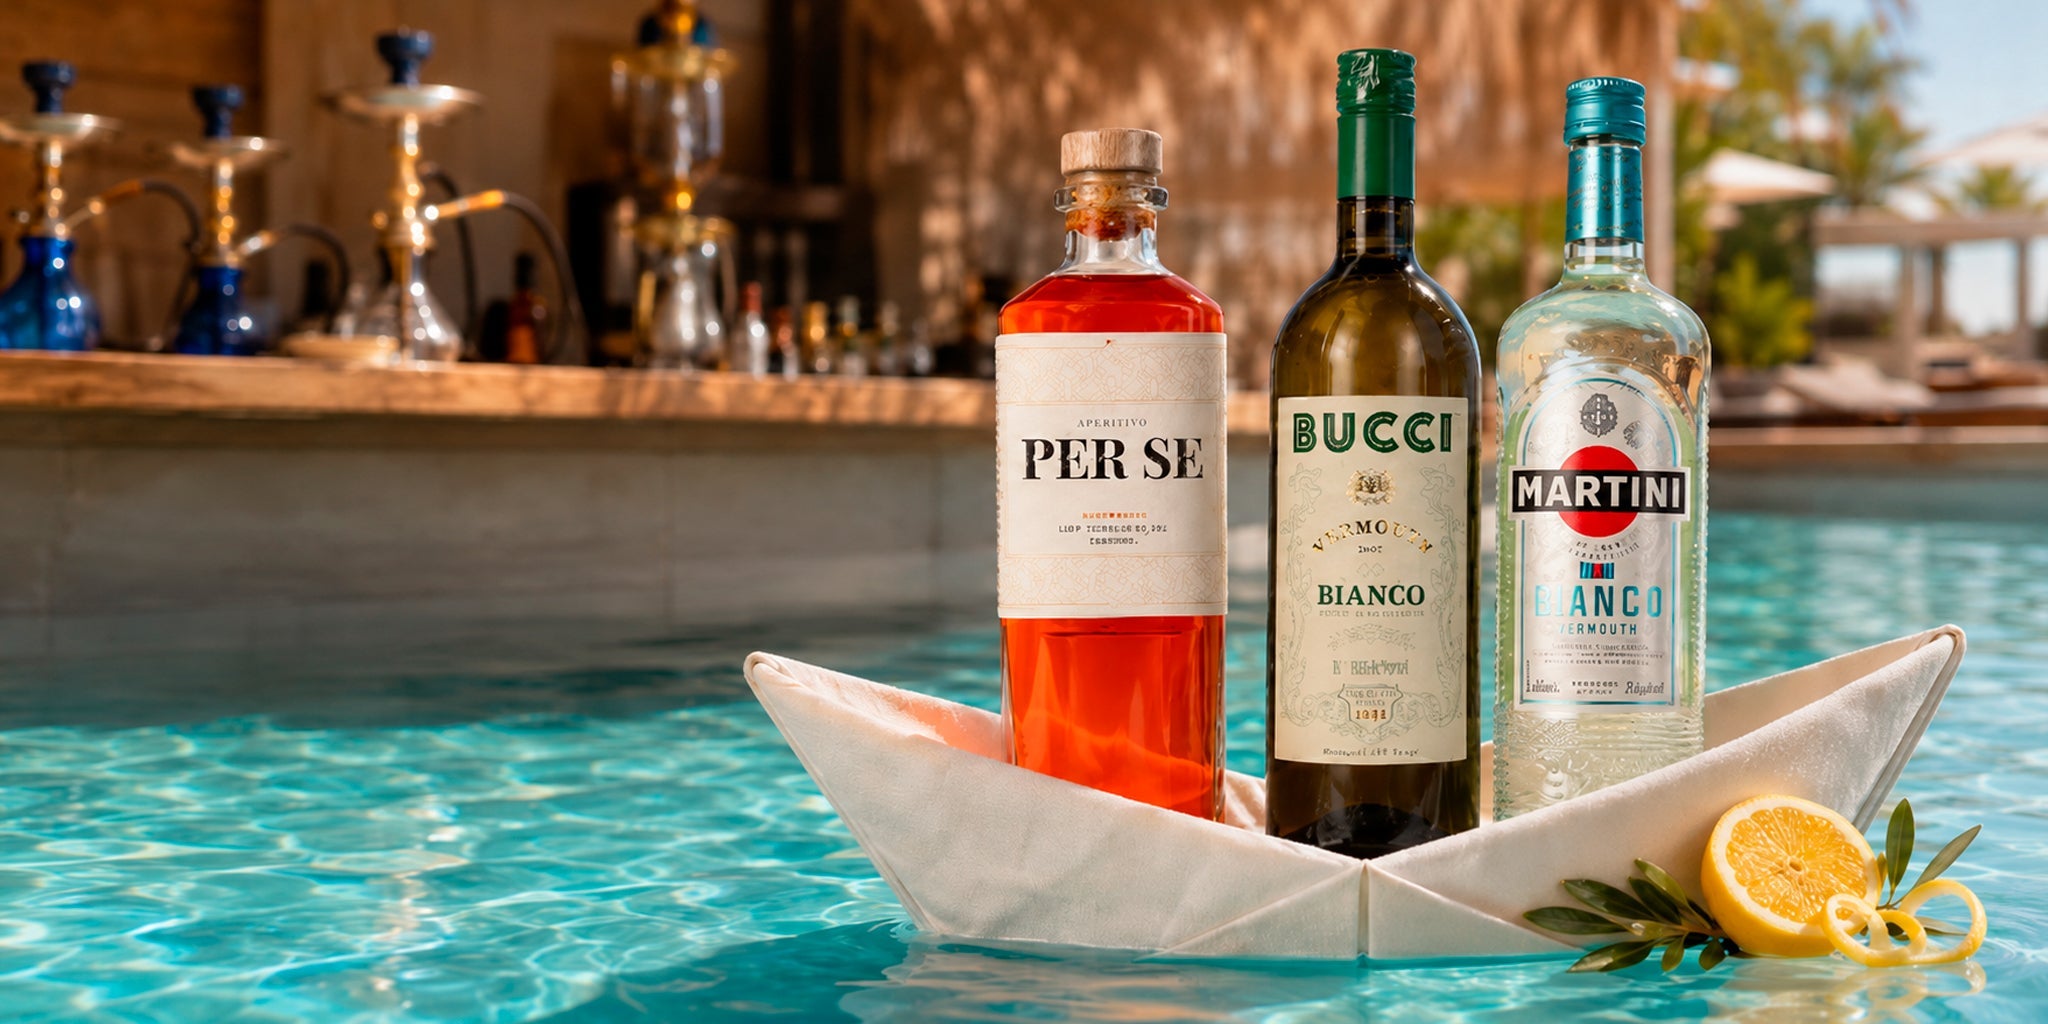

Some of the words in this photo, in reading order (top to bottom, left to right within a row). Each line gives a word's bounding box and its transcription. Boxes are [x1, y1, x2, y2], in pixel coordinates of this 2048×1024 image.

[1077, 418, 1147, 428] APERITIVO
[1293, 411, 1452, 453] BUCCI
[1021, 438, 1129, 480] PER
[1143, 437, 1204, 480] SE
[1517, 475, 1680, 508] MARTINI
[1317, 584, 1425, 606] BIANCO
[1534, 585, 1662, 617] BIANCO
